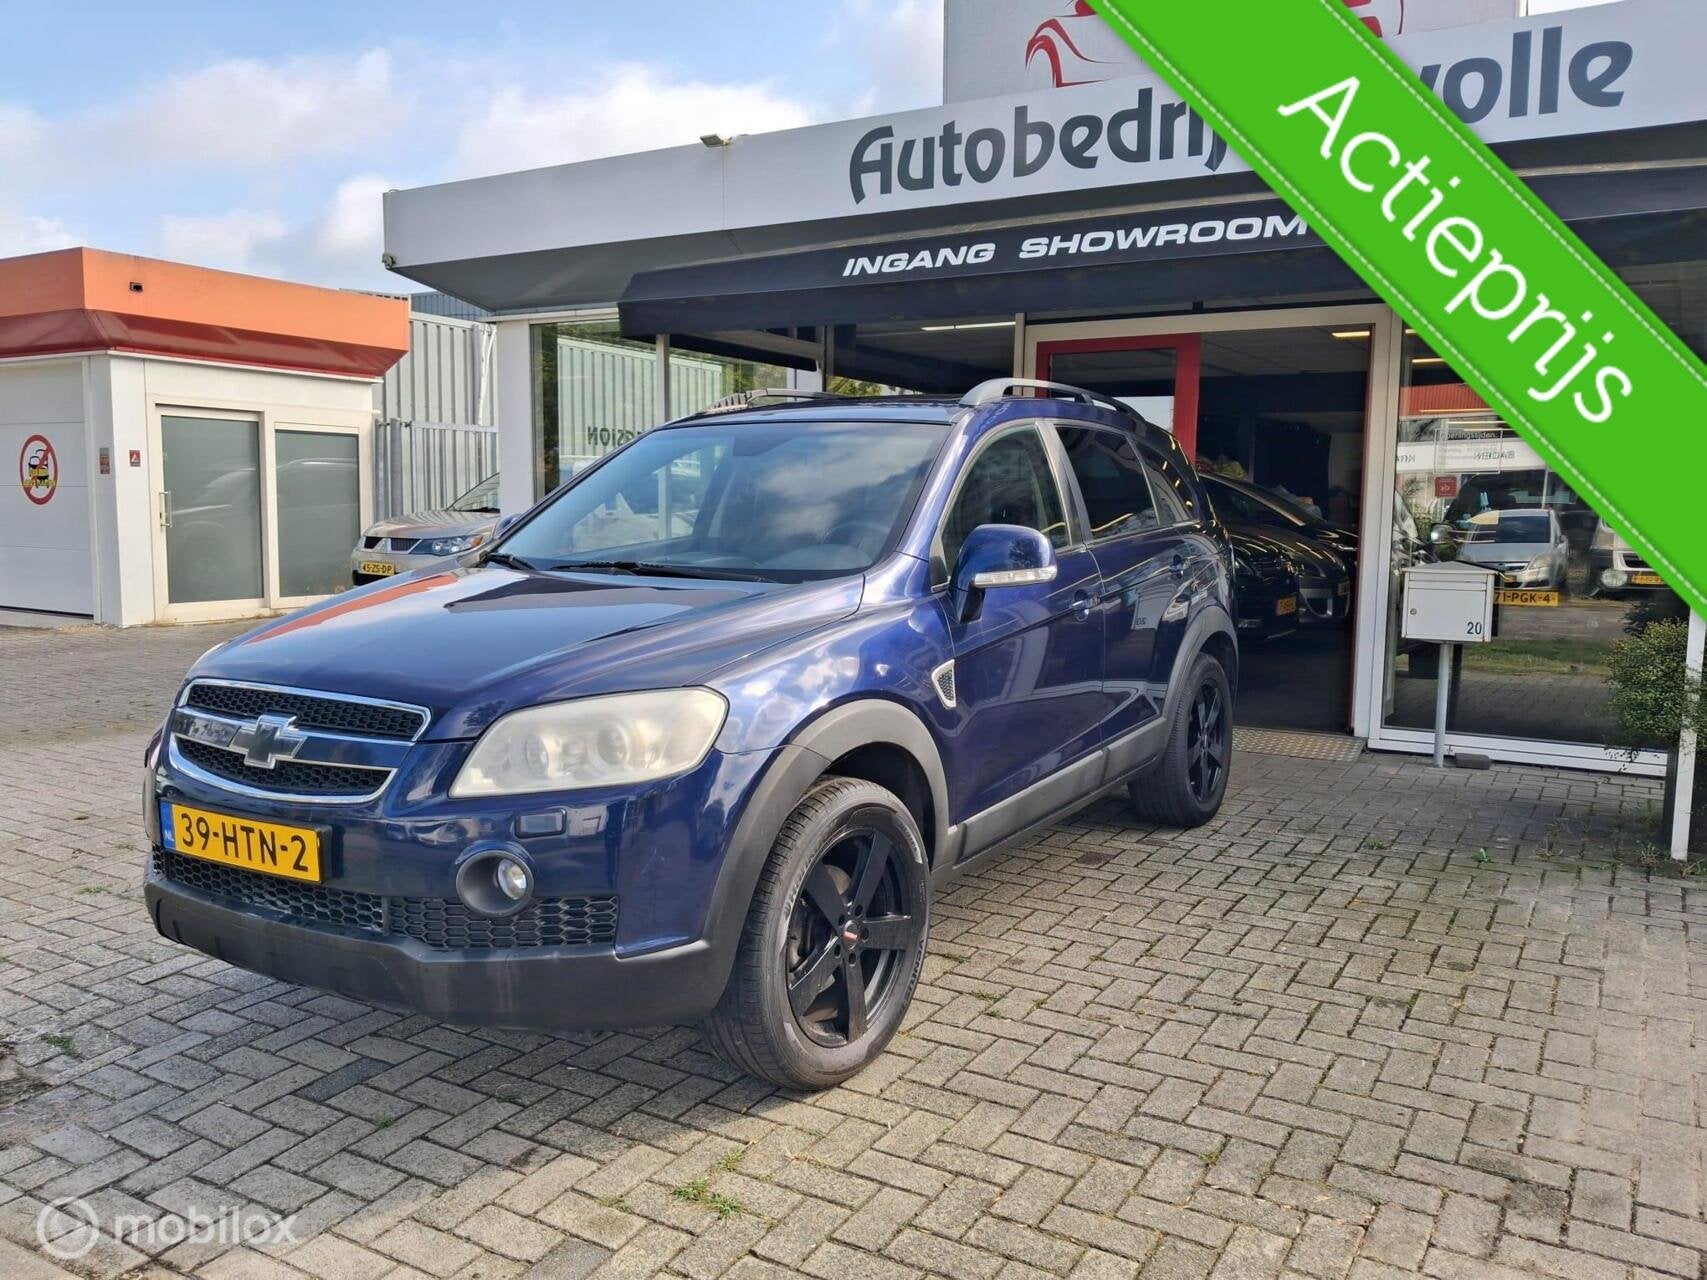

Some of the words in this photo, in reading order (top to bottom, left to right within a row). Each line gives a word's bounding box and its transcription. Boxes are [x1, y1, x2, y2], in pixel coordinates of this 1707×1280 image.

[843, 243, 997, 277] INGANG
[1018, 215, 1309, 260] SHOWROOM
[1467, 622, 1482, 635] 20
[181, 813, 309, 873] 39-HTN-2
